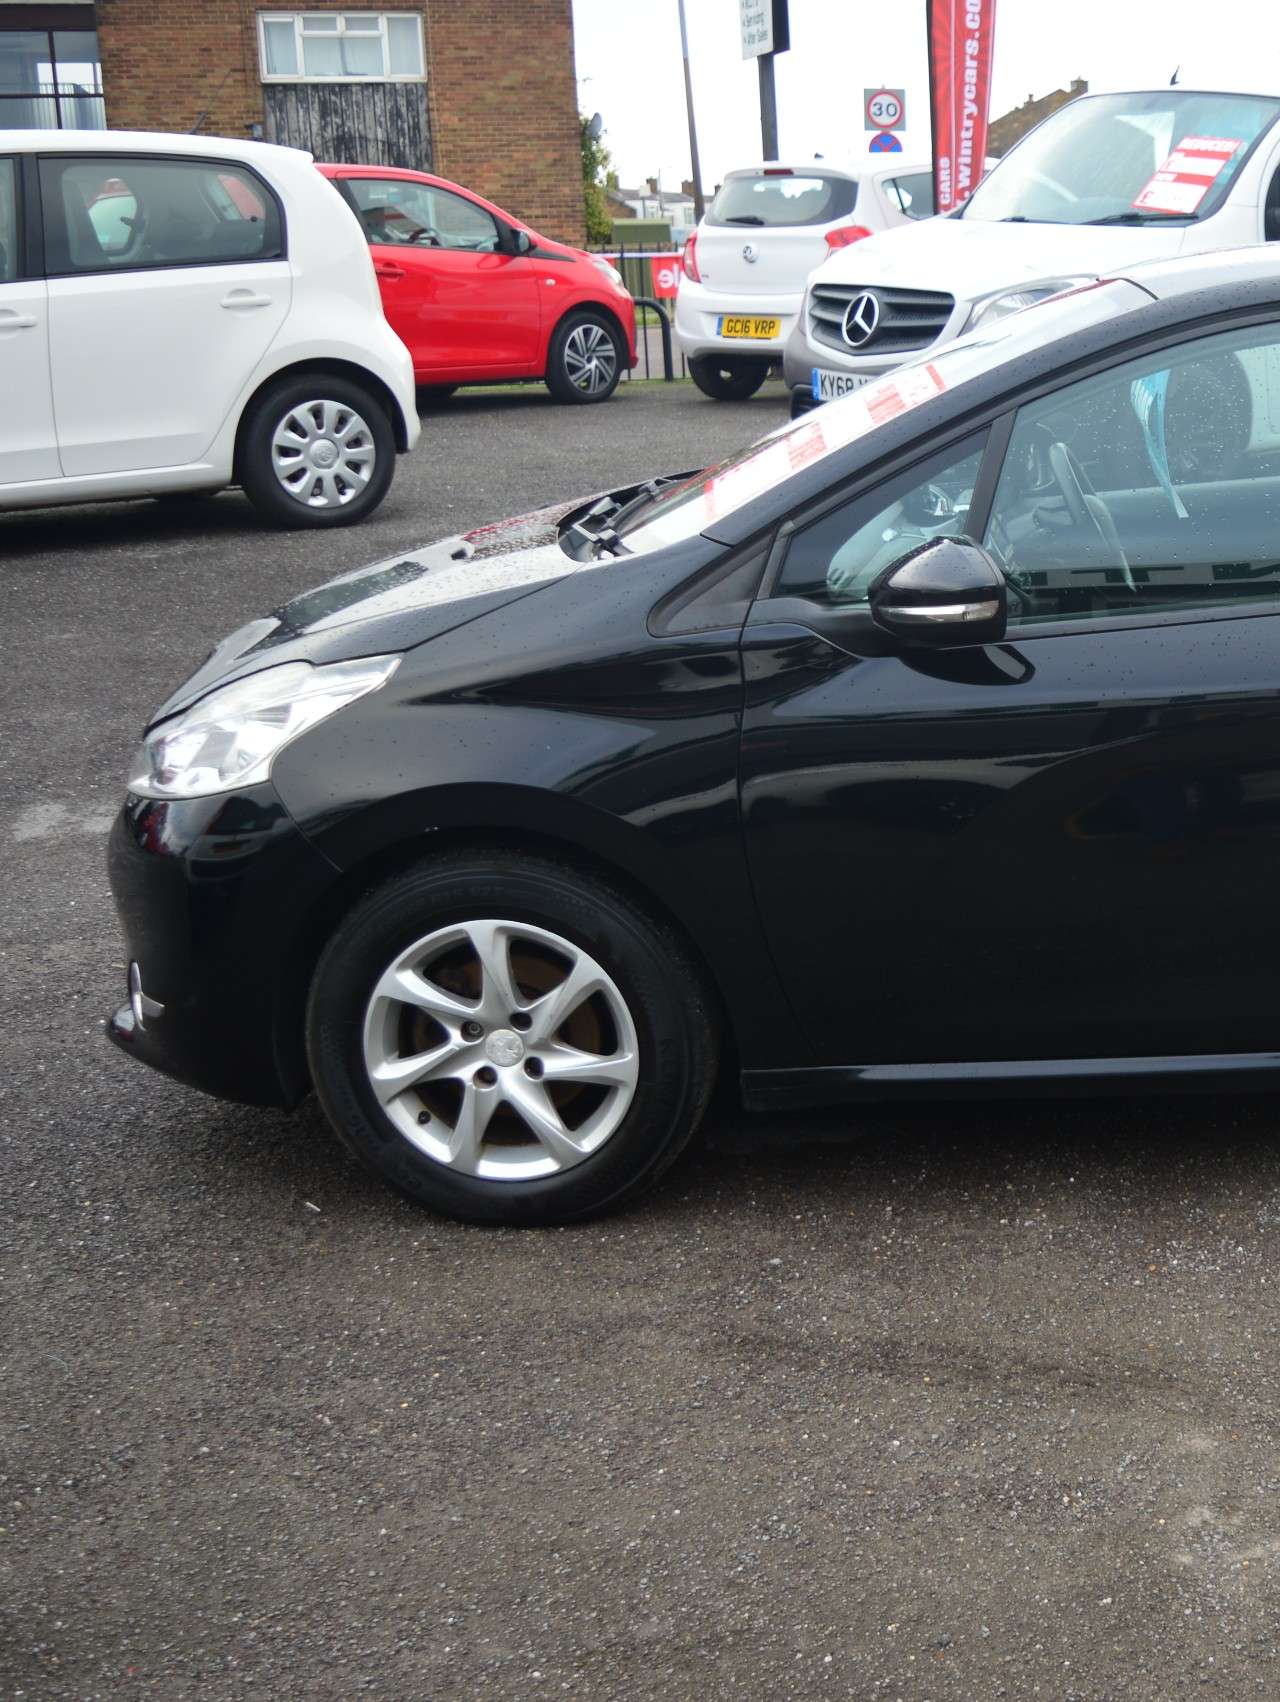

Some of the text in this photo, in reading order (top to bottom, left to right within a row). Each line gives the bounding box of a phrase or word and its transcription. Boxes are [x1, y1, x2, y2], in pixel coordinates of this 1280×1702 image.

[872, 102, 897, 117] 30
[726, 318, 776, 335] GC16 VRP
